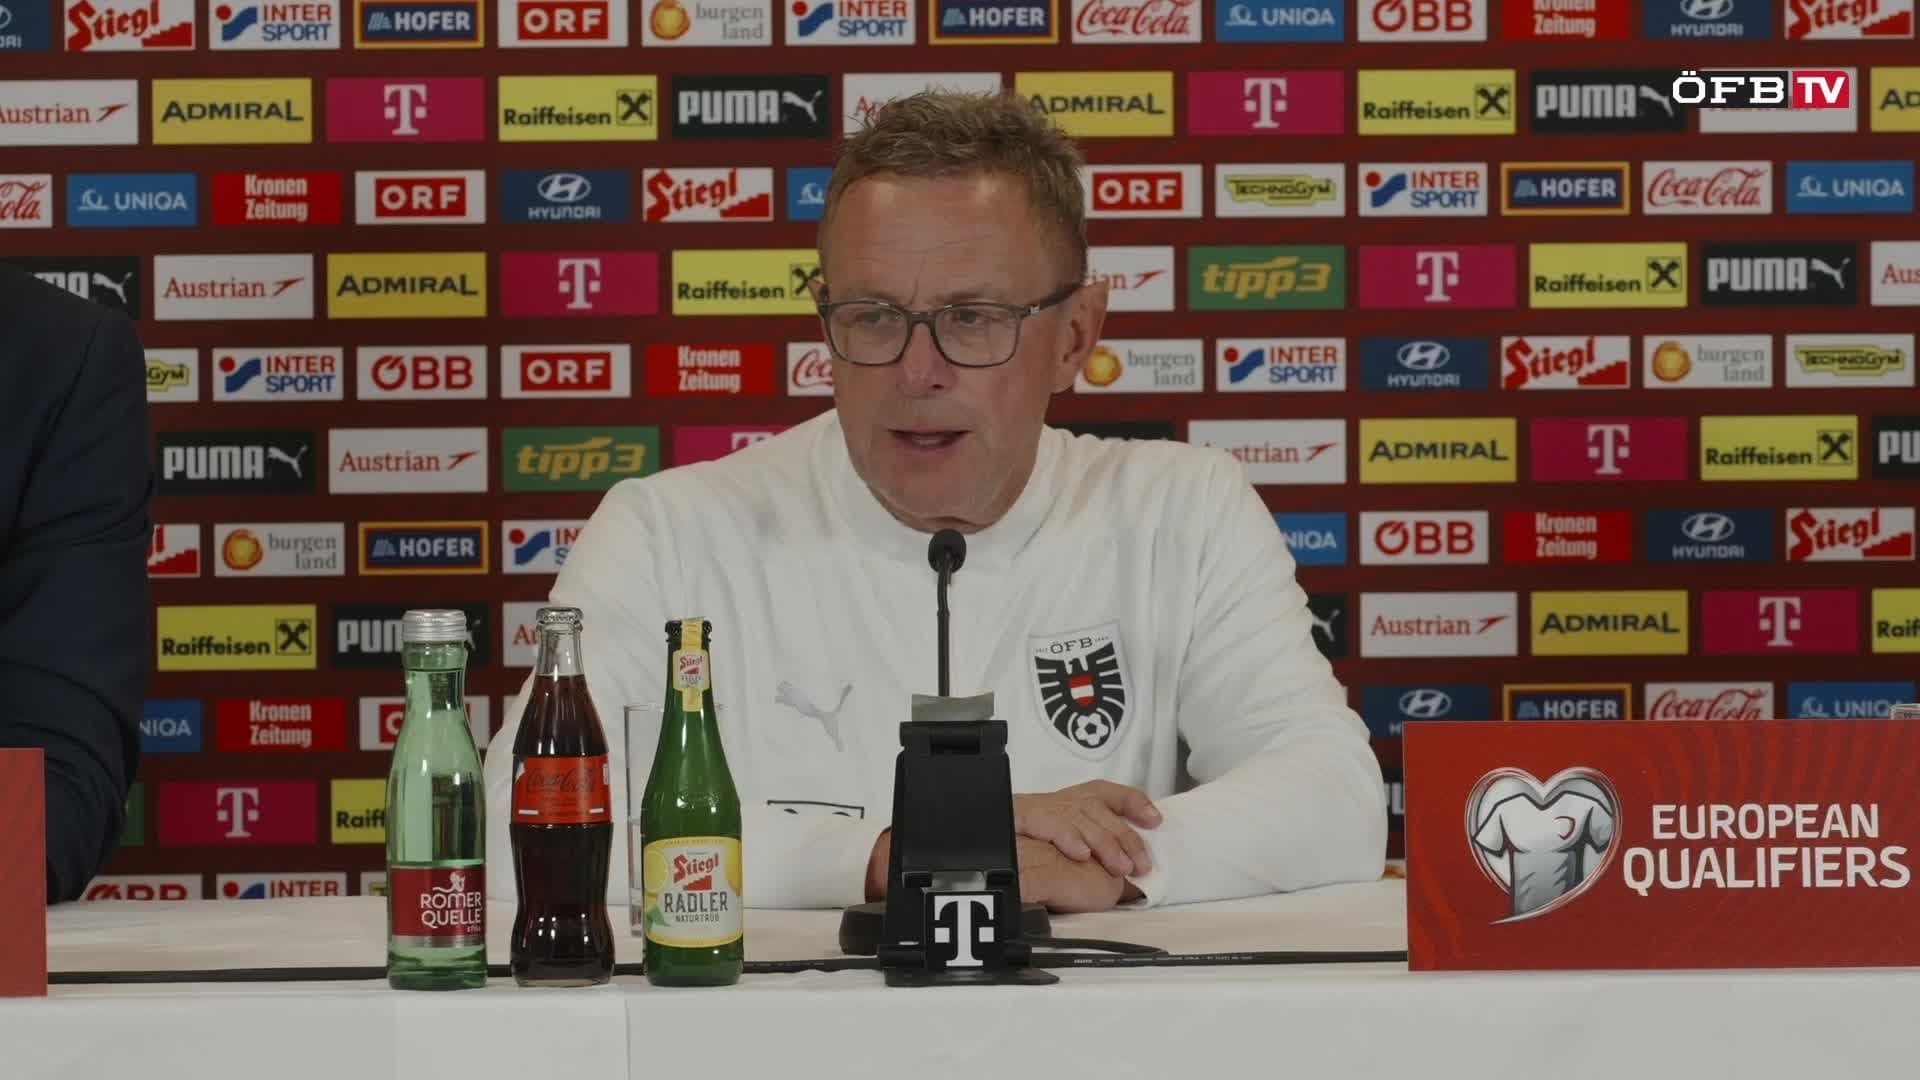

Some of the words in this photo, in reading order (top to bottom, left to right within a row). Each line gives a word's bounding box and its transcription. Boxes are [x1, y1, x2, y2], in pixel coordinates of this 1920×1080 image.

[263, 4, 332, 21] INTER
[696, 2, 764, 21] burgen
[838, 1, 907, 17] INTER
[969, 8, 1045, 27] HOFER
[1076, 0, 1190, 35] Coca-Cola
[1263, 8, 1335, 26] UNIQA
[68, 0, 161, 50] Stiegl
[395, 11, 470, 31] HOFER
[523, 8, 602, 32] ORF
[838, 20, 907, 37] SPORT
[1534, 14, 1596, 37] Zeitung
[1671, 23, 1743, 37] HYUNDAI
[263, 24, 331, 41] SPORT
[722, 24, 764, 40] land
[161, 100, 304, 122] ADMIRAL
[678, 90, 779, 124] PUMA
[1028, 93, 1164, 115] ADMIRAL
[1536, 84, 1636, 118] PUMA
[503, 108, 611, 126] Raiffeisen
[1363, 102, 1470, 121] Raiffeisen
[245, 174, 307, 196] Kronen
[1412, 171, 1479, 188] INTER
[1541, 178, 1616, 198] HOFER
[1647, 168, 1767, 208] Coca-Cola
[1833, 179, 1905, 197] UNIQA
[114, 192, 187, 210] UNIQA
[381, 185, 460, 210] ORF
[645, 168, 737, 222] Stiegl
[1099, 180, 1177, 204] ORF
[1411, 190, 1478, 208] SPORT
[245, 197, 308, 221] Zeitung
[528, 206, 600, 219] HYUNDAI
[1203, 257, 1331, 300] tipp3
[1534, 275, 1641, 293] Raiffeisen
[1707, 258, 1807, 291] PUMA
[164, 276, 266, 299] Austrian
[337, 274, 478, 296] ADMIRAL
[678, 281, 784, 300] Raiffeisen
[678, 346, 740, 367] Kronen
[1127, 350, 1195, 370] burgen
[1270, 346, 1337, 363] INTER
[1504, 336, 1595, 390] Stiegl
[1697, 343, 1765, 363] burgen
[266, 355, 335, 373] INTER
[527, 359, 605, 384] ORF
[1722, 363, 1765, 382] land
[266, 375, 335, 393] SPORT
[678, 370, 741, 393] Zeitung
[1154, 370, 1195, 386] land
[1269, 366, 1336, 384] SPORT
[1388, 374, 1460, 387] HYUNDAI
[516, 437, 646, 481] tipp3
[1231, 440, 1299, 463] strian
[1369, 440, 1509, 462] ADMIRAL
[1706, 447, 1812, 465] Raiffeisen
[163, 447, 264, 480] PUMA
[339, 451, 441, 472] Austrian
[1535, 513, 1597, 533] Kronen
[268, 532, 337, 554] burgen
[1283, 530, 1337, 549] NIQA
[1789, 508, 1880, 561] Stiegl
[399, 538, 475, 558] HOFER
[1535, 536, 1598, 560] Zeitung
[1672, 546, 1744, 559] HYUNDAI
[296, 552, 337, 570] land
[1371, 614, 1471, 636] Austrian
[1540, 612, 1679, 634] ADMIRAL
[162, 636, 271, 656] Raiffeisen
[337, 620, 403, 653] PUM
[1050, 636, 1093, 654] ÖFB
[250, 701, 312, 722] Kronen
[1544, 701, 1618, 719] HOFER
[1834, 699, 1889, 718] UNIQ
[139, 719, 192, 737] NIQA
[250, 726, 312, 748] Zeitung
[1652, 804, 1879, 840] EUROPEAN
[673, 852, 719, 883] Stiegl
[1622, 846, 1911, 897] QUALIFIERS
[270, 880, 338, 897] INTER
[664, 891, 728, 913] RADLER
[421, 909, 481, 928] QUELLE
